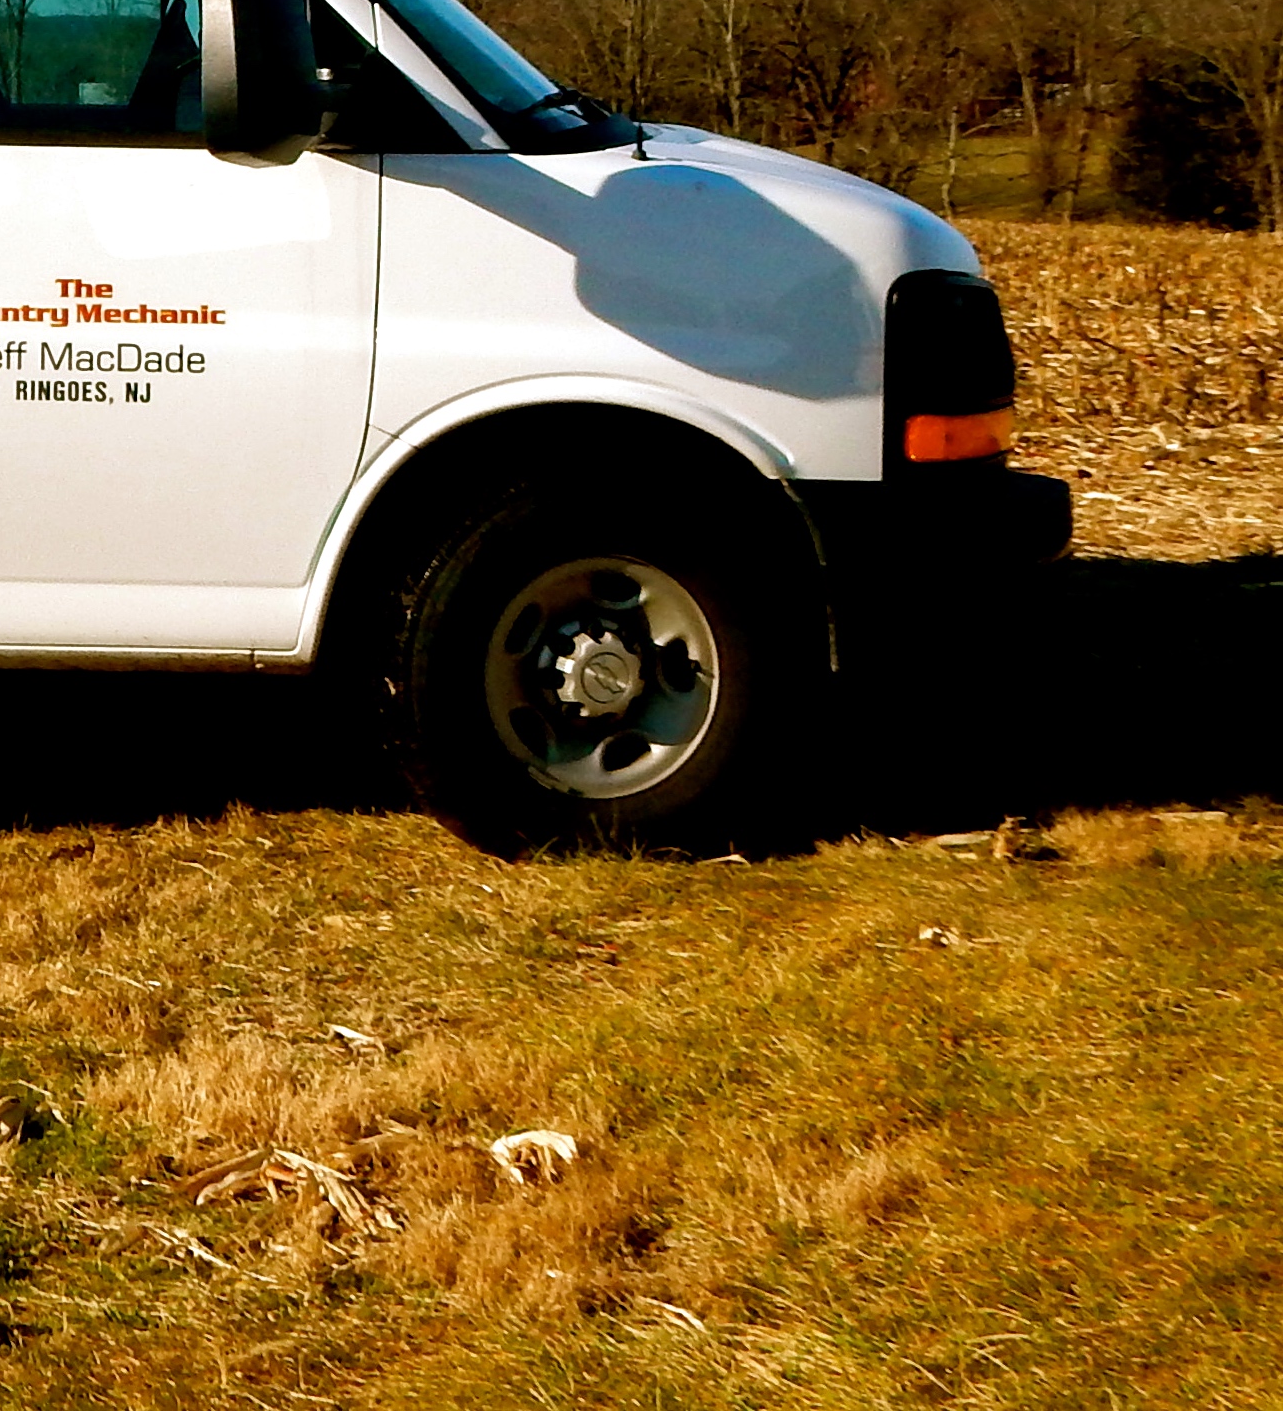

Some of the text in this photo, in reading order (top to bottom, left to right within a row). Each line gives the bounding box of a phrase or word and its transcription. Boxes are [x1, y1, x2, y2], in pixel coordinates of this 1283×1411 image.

[55, 279, 112, 298] The
[77, 304, 225, 324] Mechanic
[41, 342, 205, 373] MacDade
[16, 381, 150, 404] RINGOES, NJ
